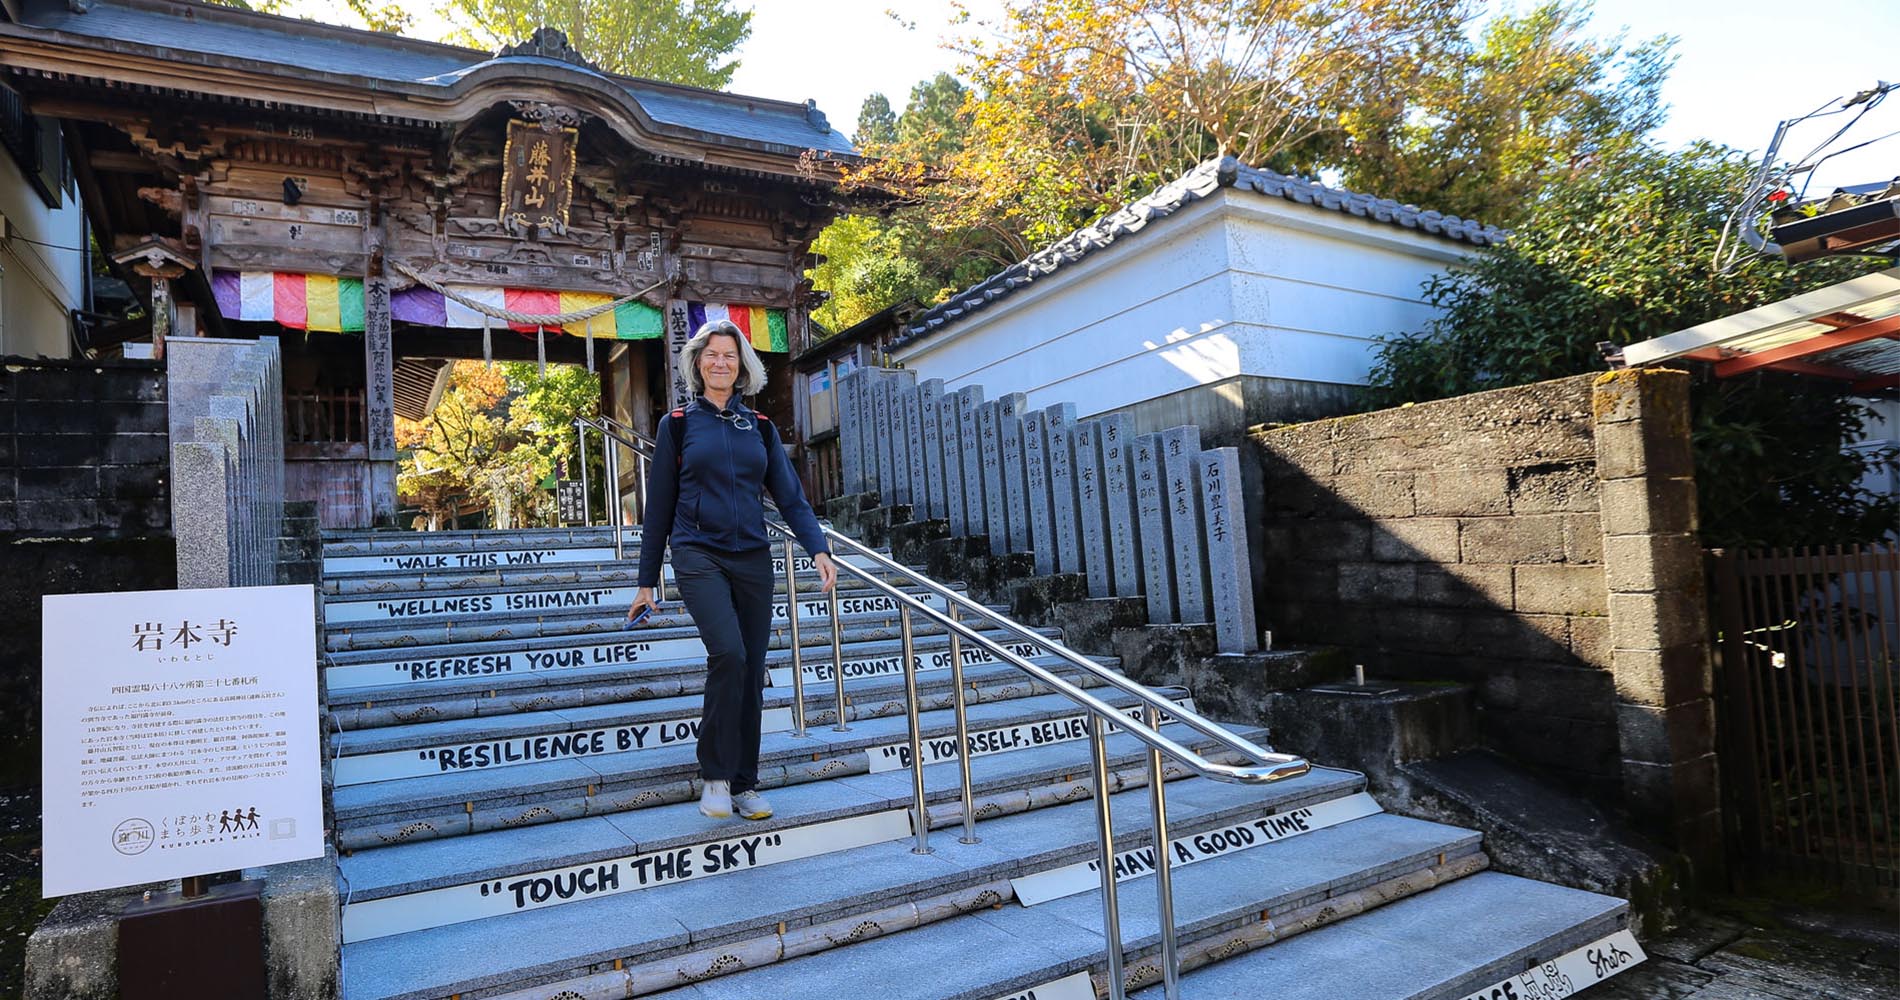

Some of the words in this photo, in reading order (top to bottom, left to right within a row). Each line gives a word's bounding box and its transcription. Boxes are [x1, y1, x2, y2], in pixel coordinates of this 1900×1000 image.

[383, 555, 448, 569] "WALK
[456, 552, 499, 567] THIS
[506, 550, 556, 566] WAY"
[377, 596, 493, 617] "WELLNESS
[131, 618, 239, 652] 岩本寺
[158, 653, 215, 664] いわもとじ
[394, 655, 512, 681] "REFRESH
[526, 649, 584, 670] YOUR
[593, 643, 651, 663] LIFE"
[419, 731, 605, 771] "RESILIENCE
[616, 726, 649, 750] BY
[660, 720, 703, 744] LOV
[160, 824, 216, 840] まち歩き
[161, 812, 217, 828] くぼかわ
[1173, 841, 1195, 863] A
[1194, 826, 1256, 855] GOOD
[1254, 808, 1313, 840] TIME"
[480, 863, 619, 909] "TOUCH
[631, 848, 693, 885] THE
[702, 834, 782, 874] SKY"
